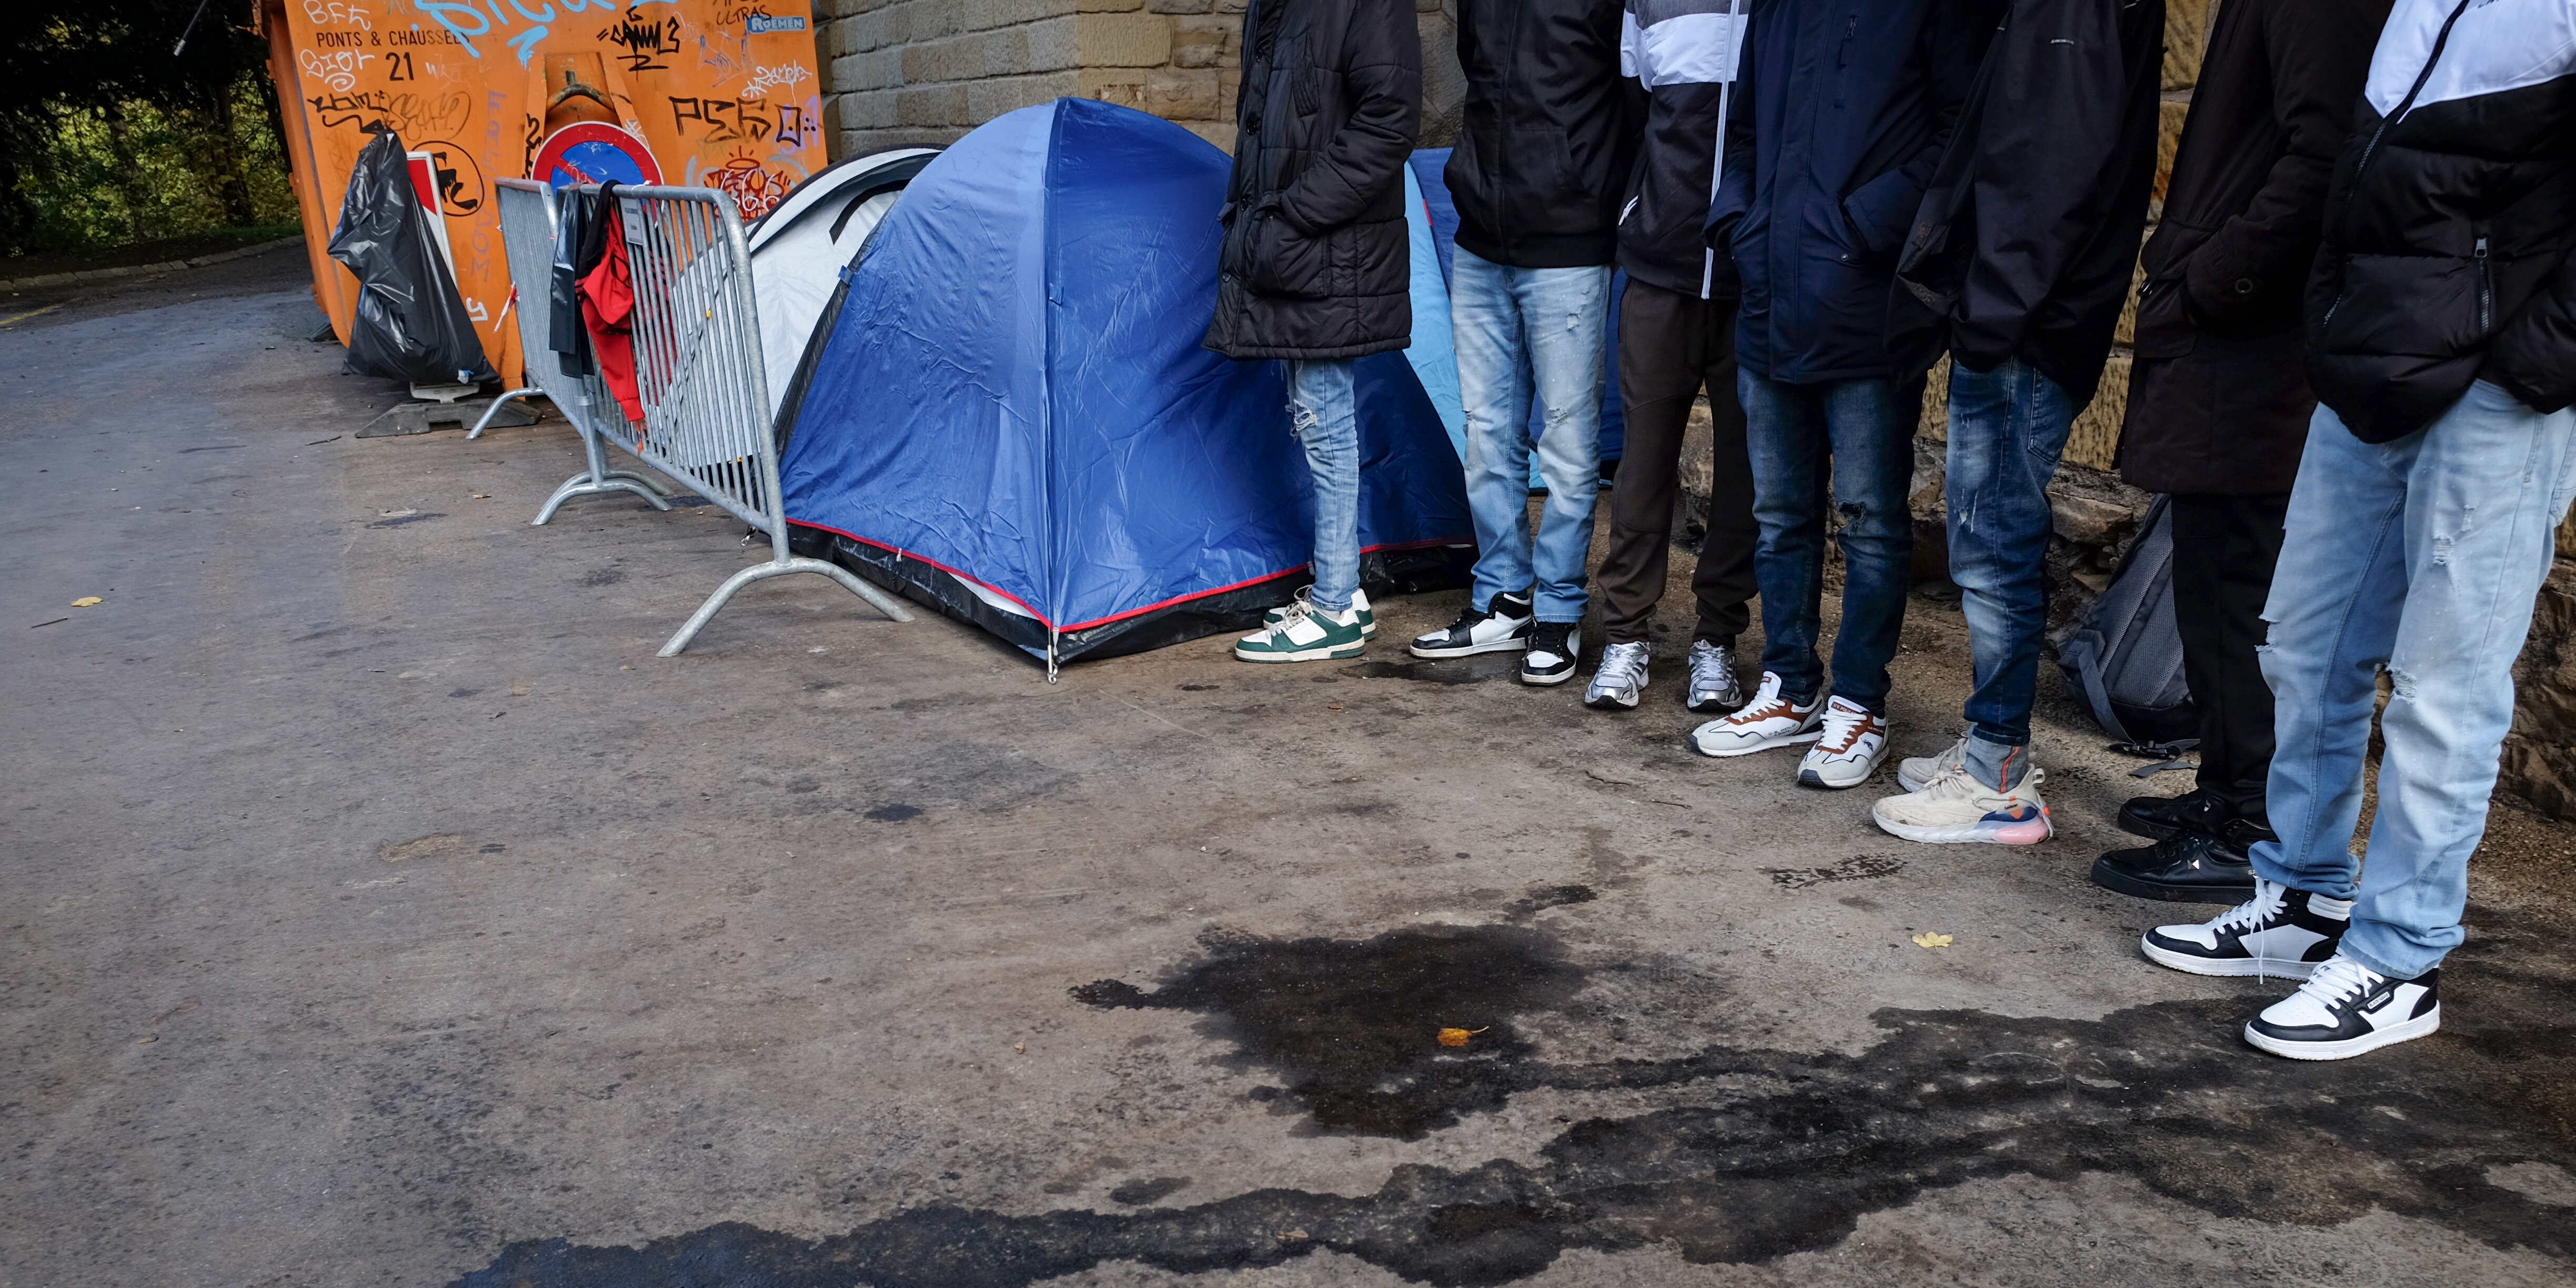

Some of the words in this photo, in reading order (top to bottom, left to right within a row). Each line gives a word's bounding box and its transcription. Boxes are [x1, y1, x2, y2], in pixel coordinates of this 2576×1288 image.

[716, 5, 771, 25] ULTRAS
[751, 17, 803, 31] ROEMEN
[316, 32, 363, 47] PONTS
[371, 31, 382, 46] &
[385, 52, 415, 81] 21
